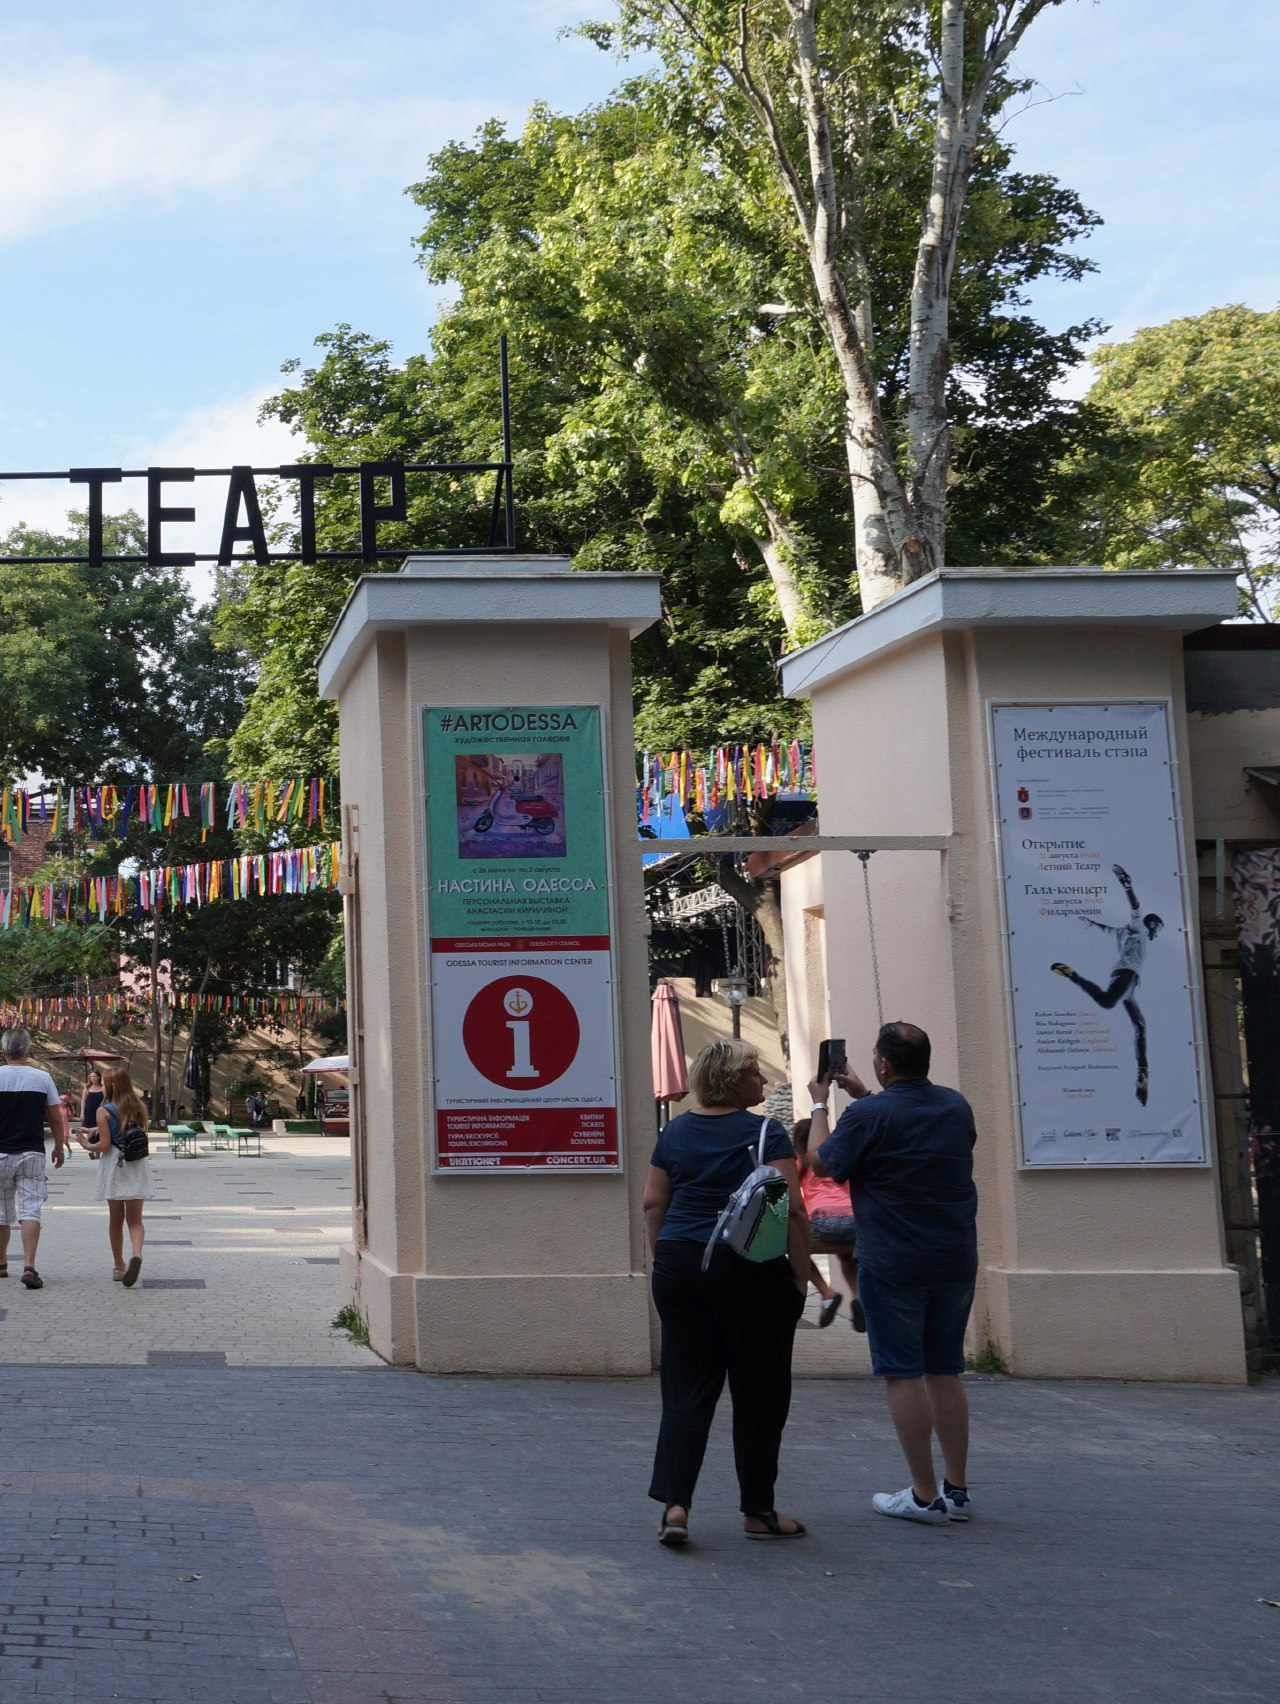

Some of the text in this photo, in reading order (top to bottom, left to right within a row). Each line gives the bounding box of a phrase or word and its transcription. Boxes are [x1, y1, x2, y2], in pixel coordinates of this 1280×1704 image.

[70, 461, 406, 567] ТЕАТР
[440, 713, 578, 732] #ARTODESSA
[454, 735, 571, 744] художественная галерея
[1013, 726, 1148, 743] Международный
[1016, 746, 1148, 762] фестиваль стэпа
[1022, 839, 1085, 852] Открытие
[1074, 862, 1101, 872] Театр
[438, 877, 597, 893] НАСТИНА ОДЕССА
[1024, 884, 1109, 897] Гала-концерт
[528, 897, 570, 905] ВЫСТАВКА
[446, 958, 593, 967] ODESSA TOURIST INFORMATION CENTER
